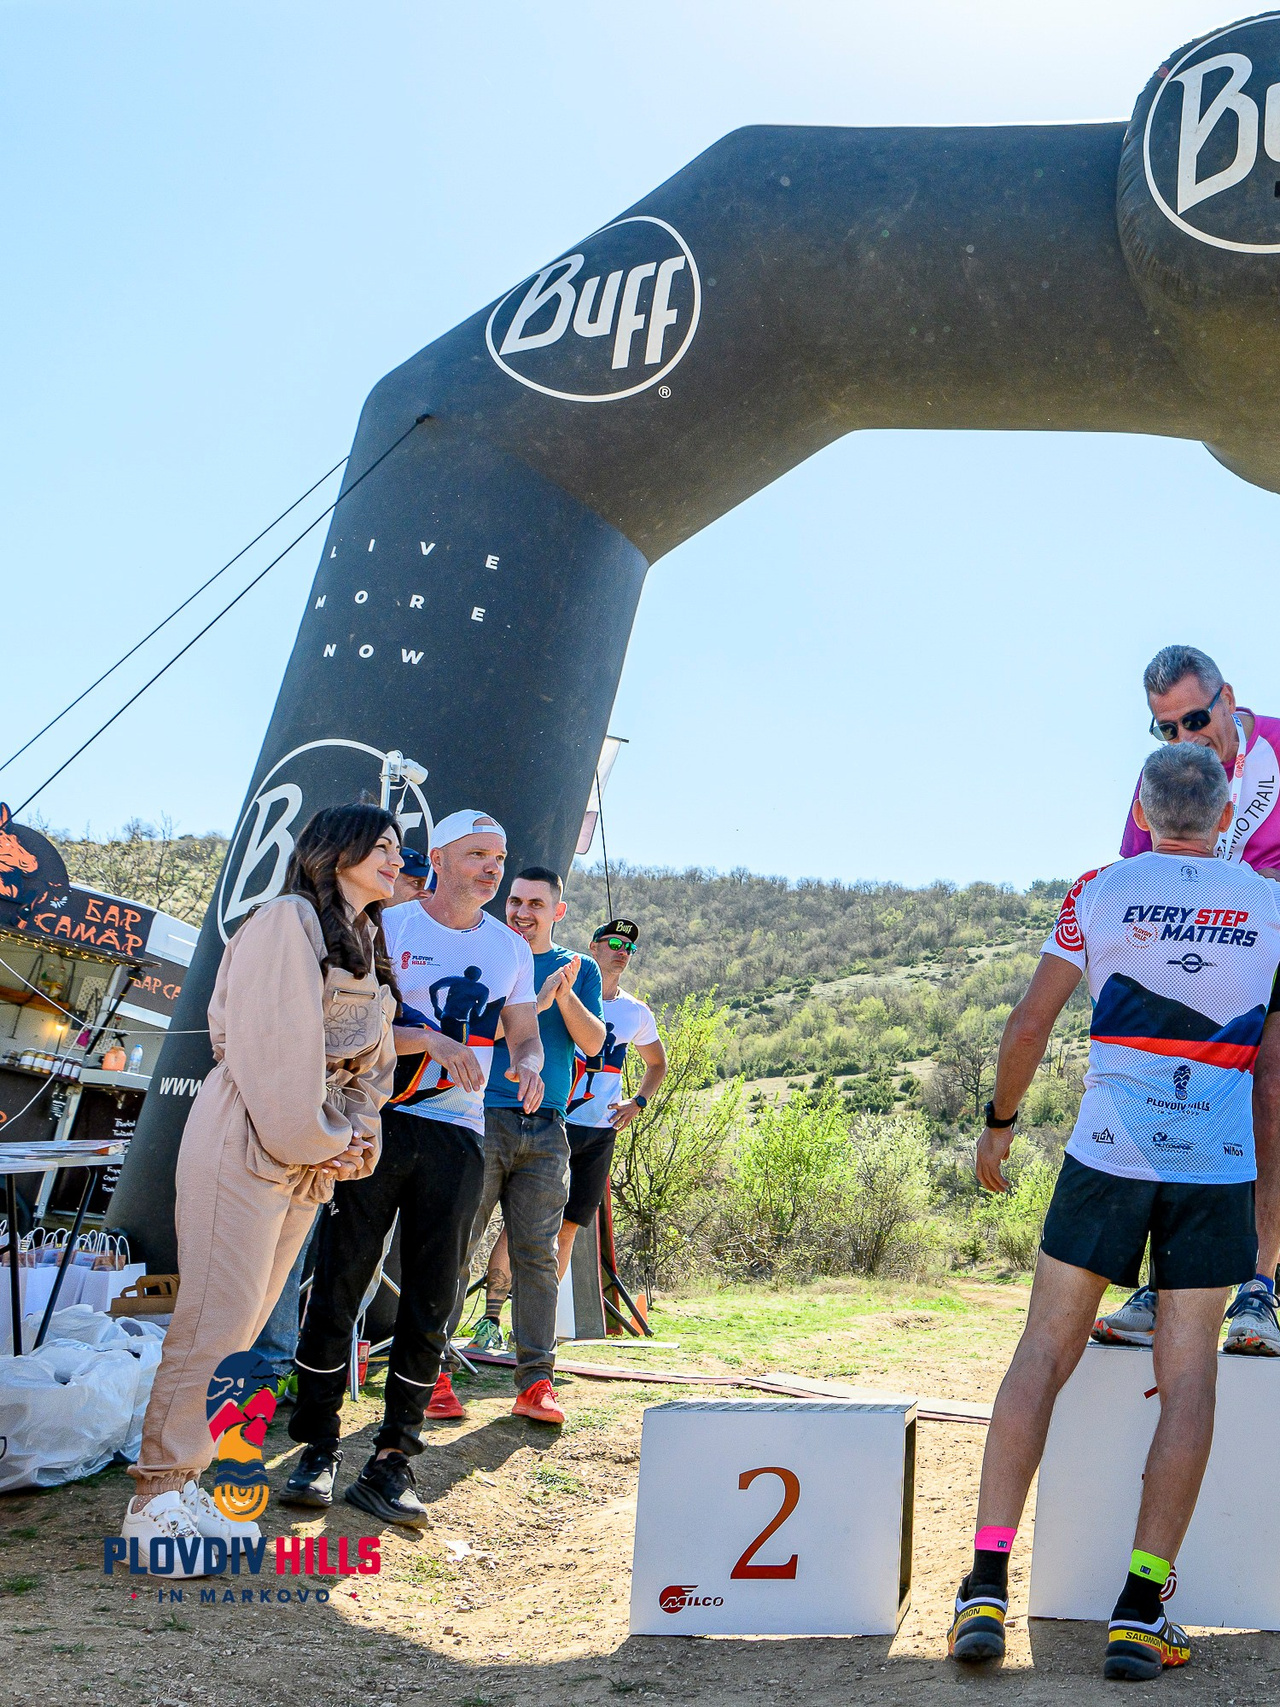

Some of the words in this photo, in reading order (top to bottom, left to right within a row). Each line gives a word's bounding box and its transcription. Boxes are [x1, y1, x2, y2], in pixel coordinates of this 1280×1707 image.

[330, 538, 500, 570] LIVE
[323, 643, 424, 665] NOW
[1243, 775, 1275, 819] TRAIL
[85, 899, 142, 931] БАР
[1122, 905, 1195, 923] EVERY
[1194, 908, 1249, 927] STEP
[1160, 924, 1258, 947] MATTERS
[1146, 1097, 1186, 1111] PLOVDIV
[730, 1466, 801, 1580] 2
[661, 1595, 724, 1609] MILCO
[1125, 1632, 1161, 1648] SALOMON
